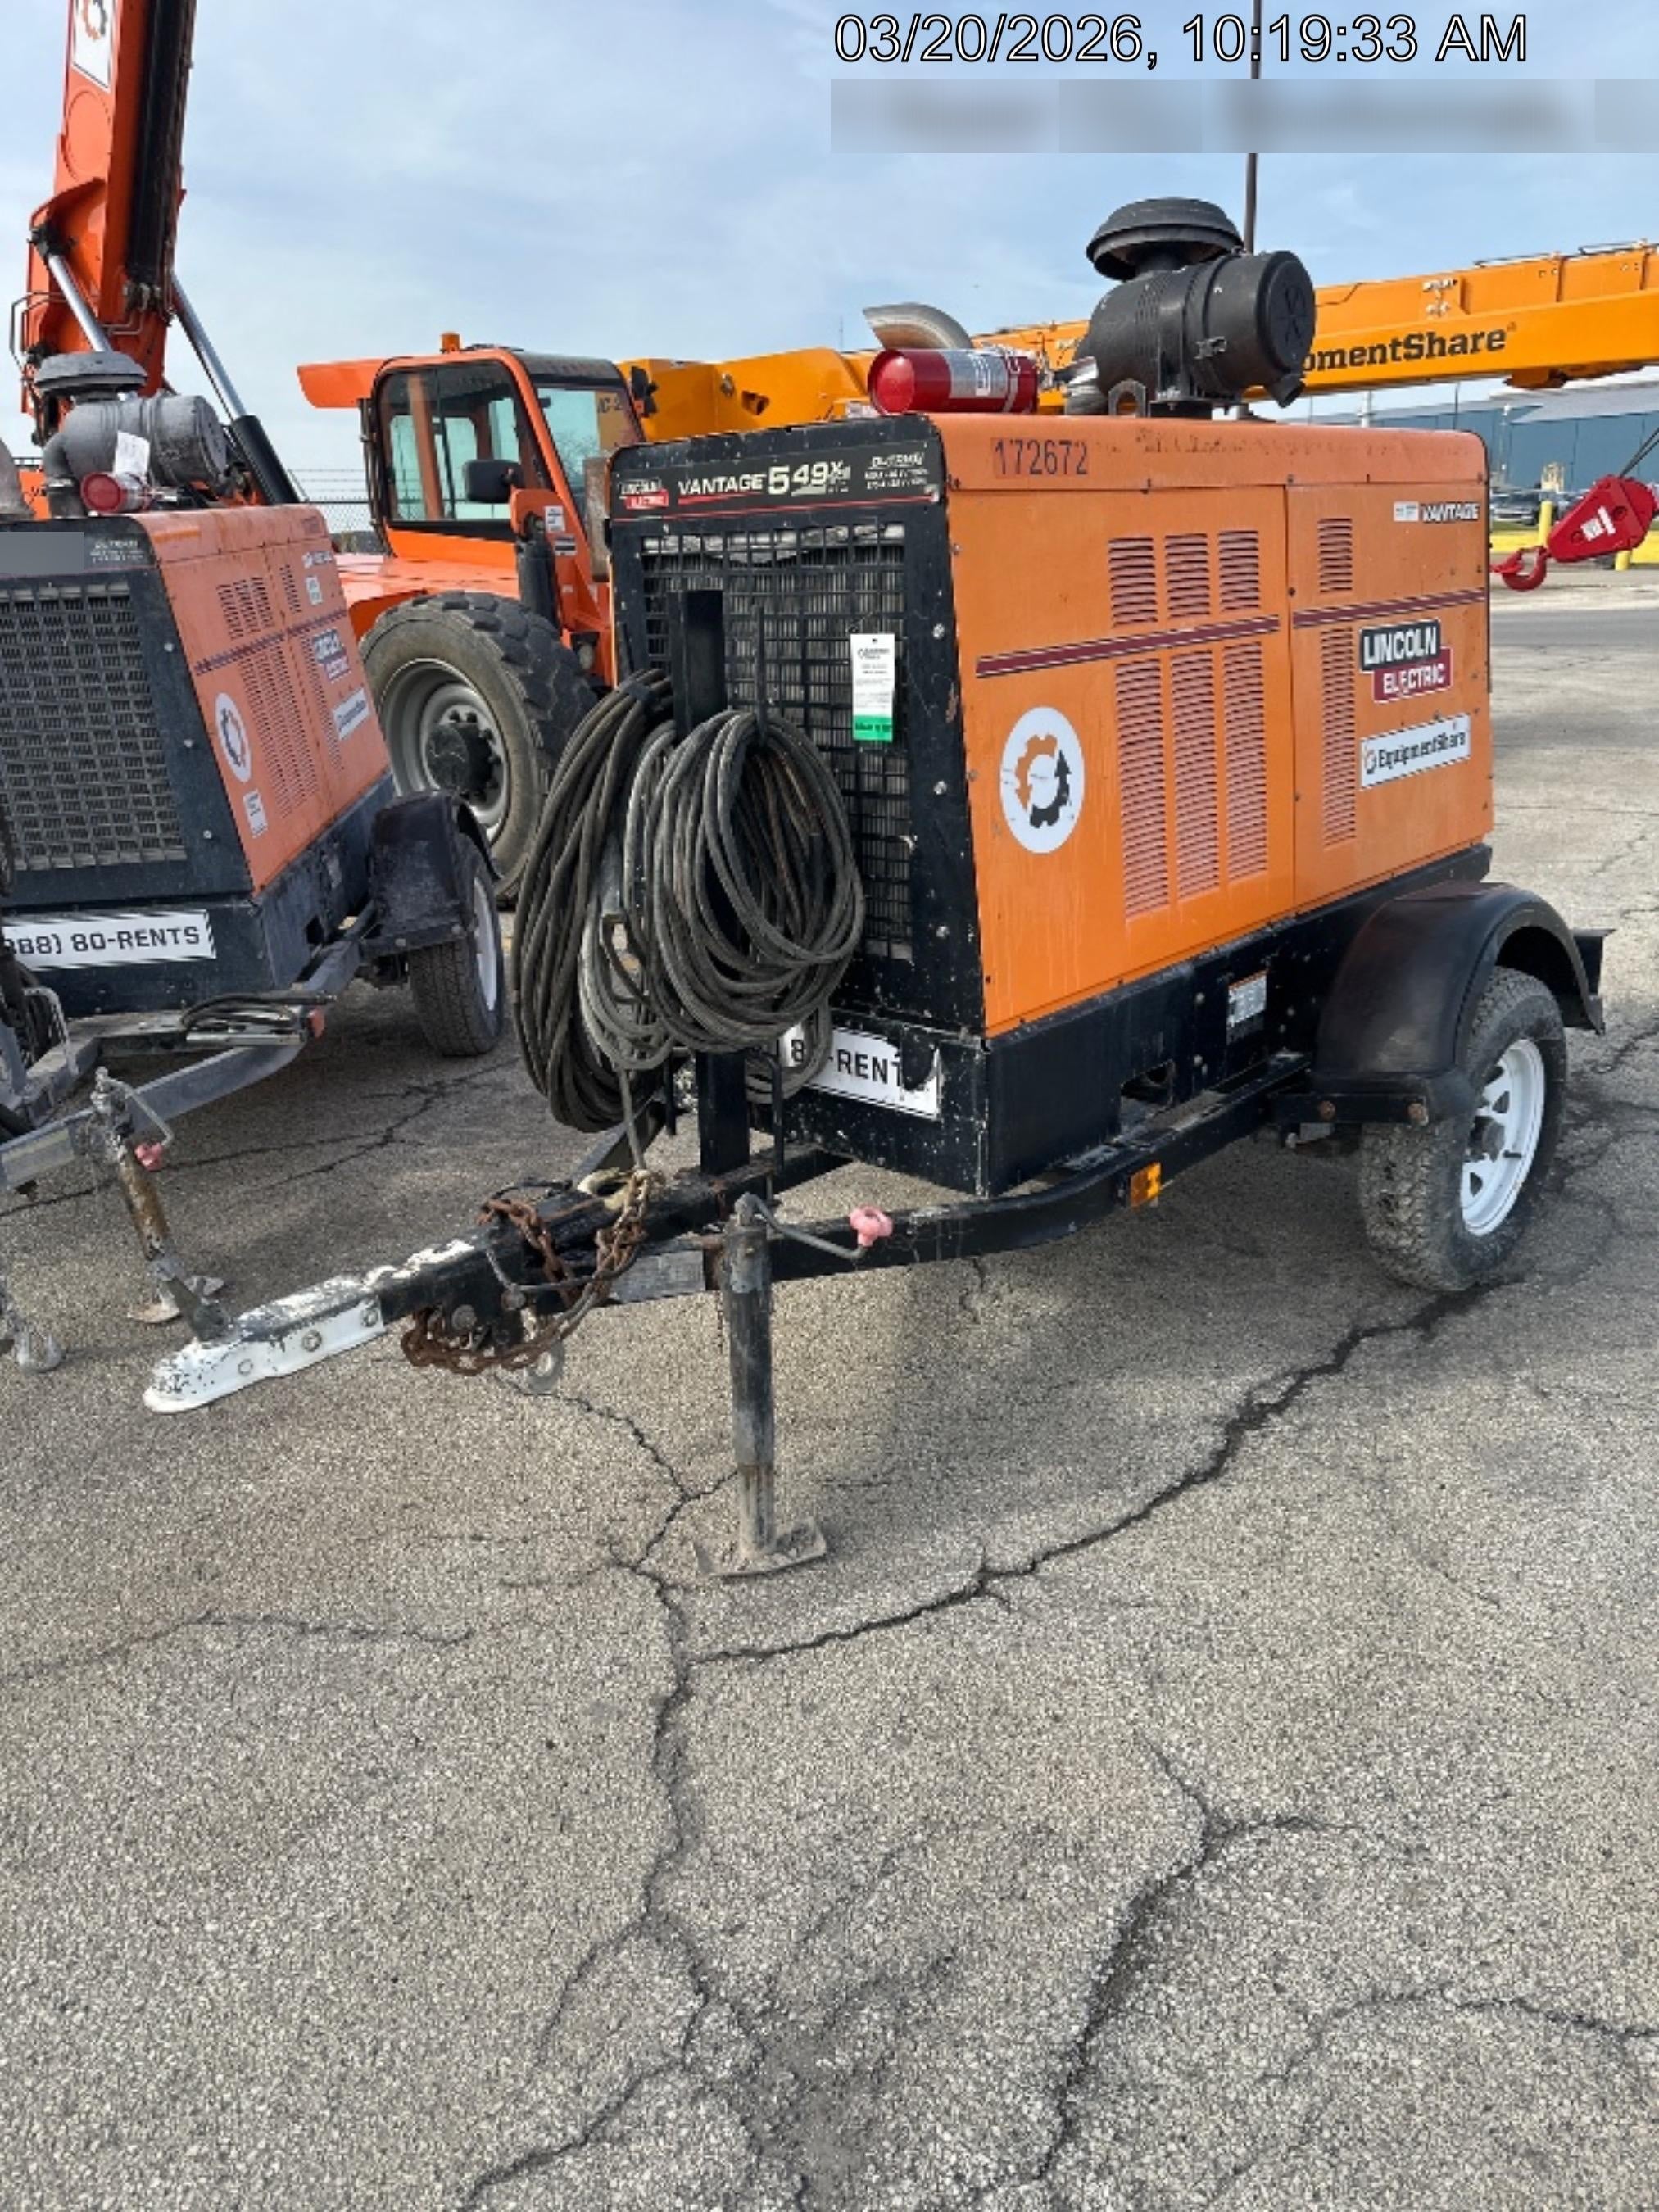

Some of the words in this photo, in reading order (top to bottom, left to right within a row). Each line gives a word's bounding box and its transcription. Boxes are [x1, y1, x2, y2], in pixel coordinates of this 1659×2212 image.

[995, 439, 1088, 474] 172672
[678, 473, 766, 495] VANTAGE
[1363, 626, 1437, 666] LINCOLN
[1383, 663, 1446, 695] ELECTRIC
[71, 926, 200, 952] 80-RENTS
